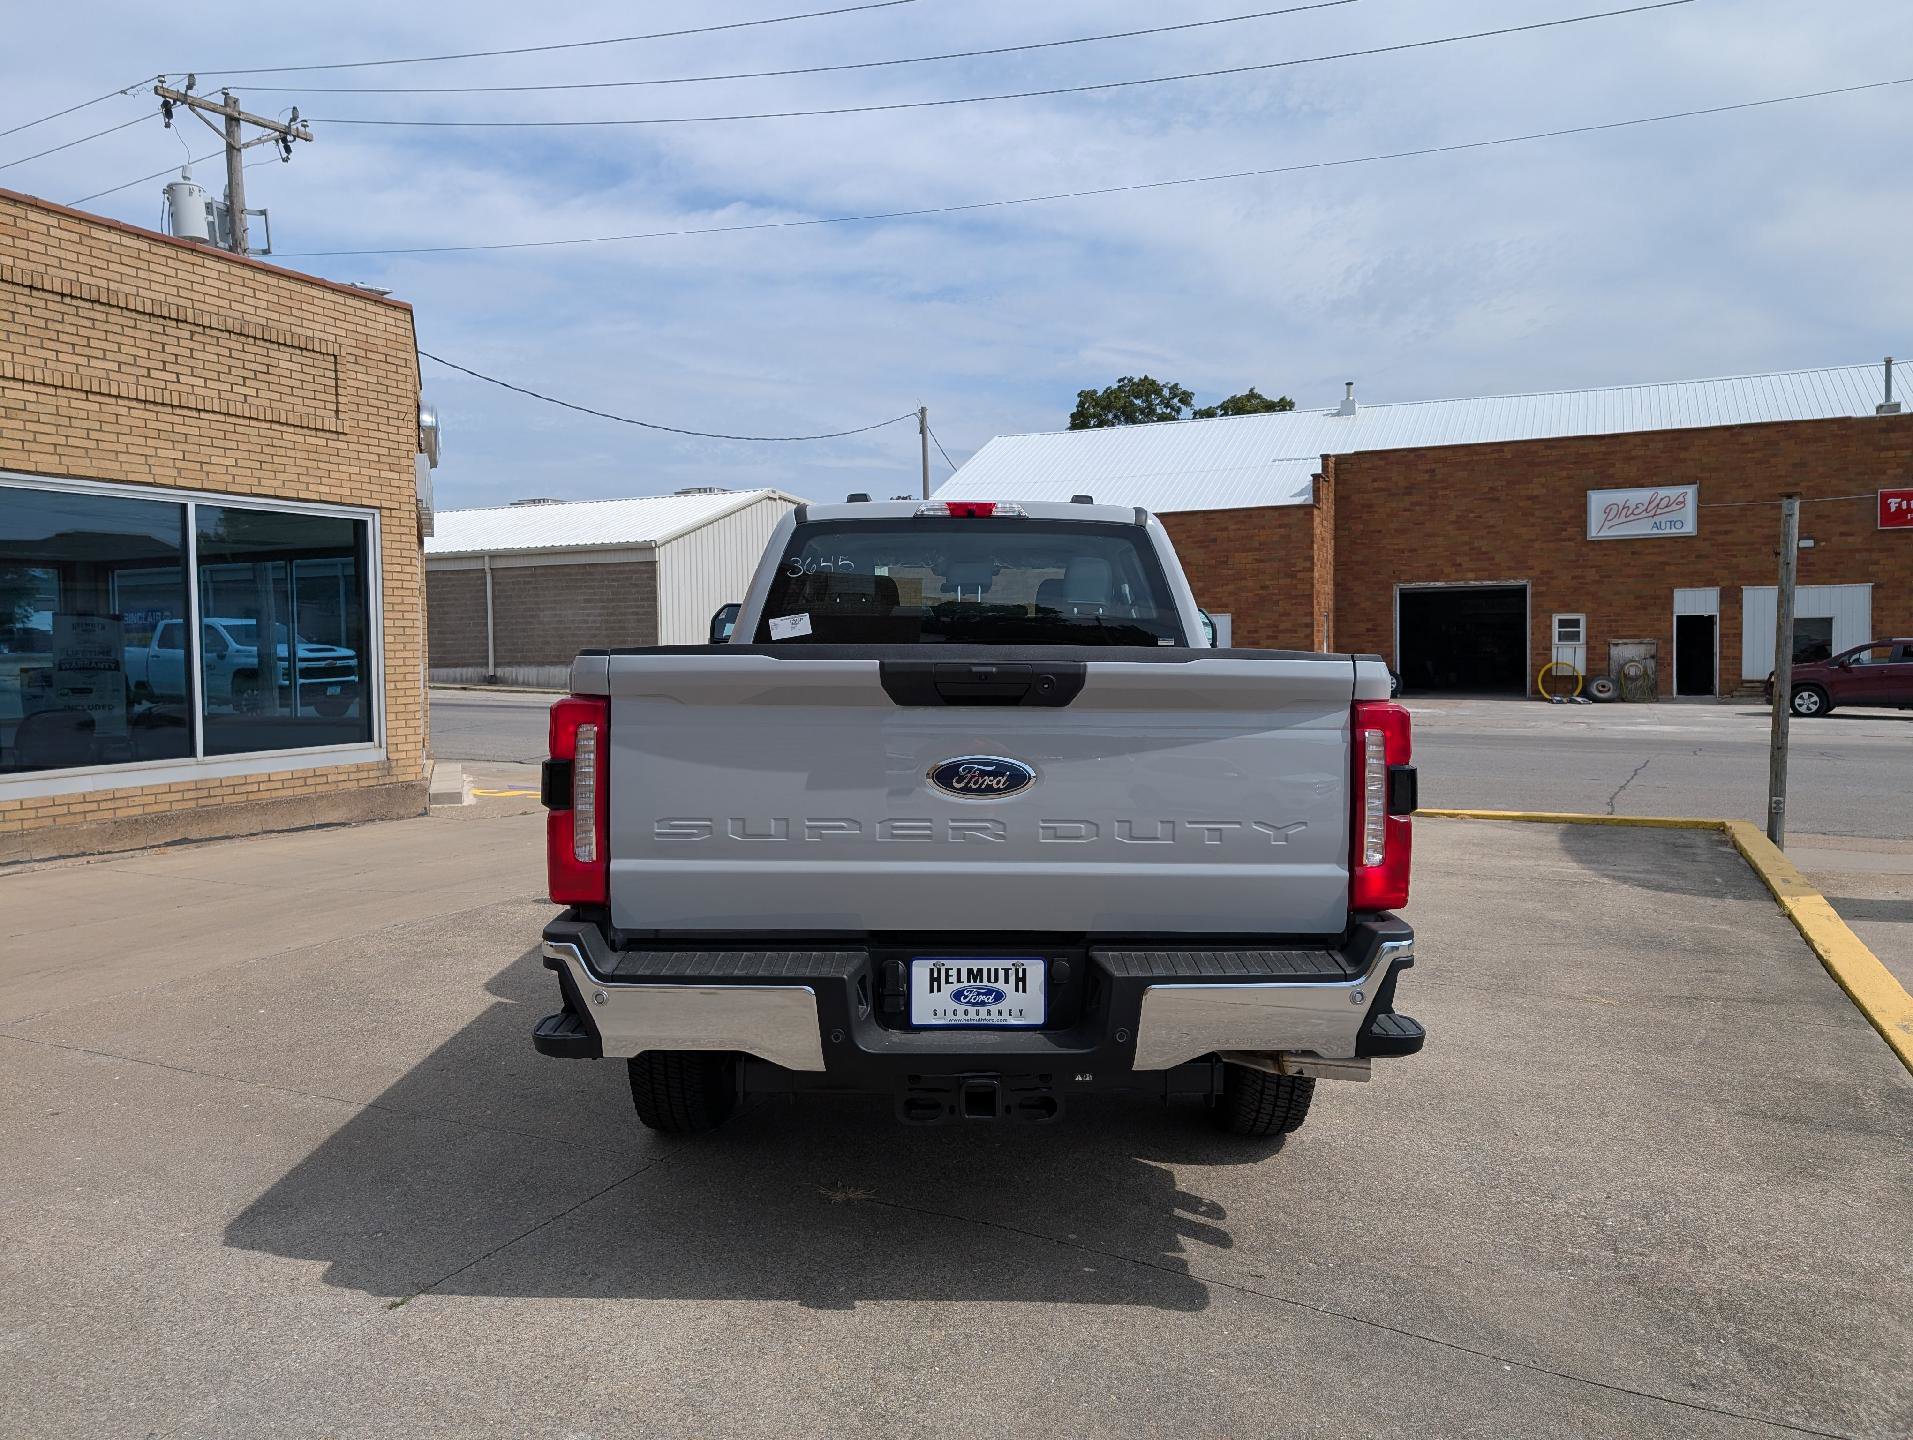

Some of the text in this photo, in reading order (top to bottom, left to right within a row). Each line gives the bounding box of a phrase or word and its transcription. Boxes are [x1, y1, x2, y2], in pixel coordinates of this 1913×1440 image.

[1596, 492, 1688, 535] Phelps
[1651, 519, 1684, 531] AUTO
[786, 556, 855, 578] 3645
[952, 764, 1010, 789] Ford
[654, 817, 1309, 845] SUPER DUTY
[929, 967, 1028, 994] HELMUTH
[960, 988, 996, 1003] Ford
[932, 1008, 1025, 1017] SIGOURNEY
